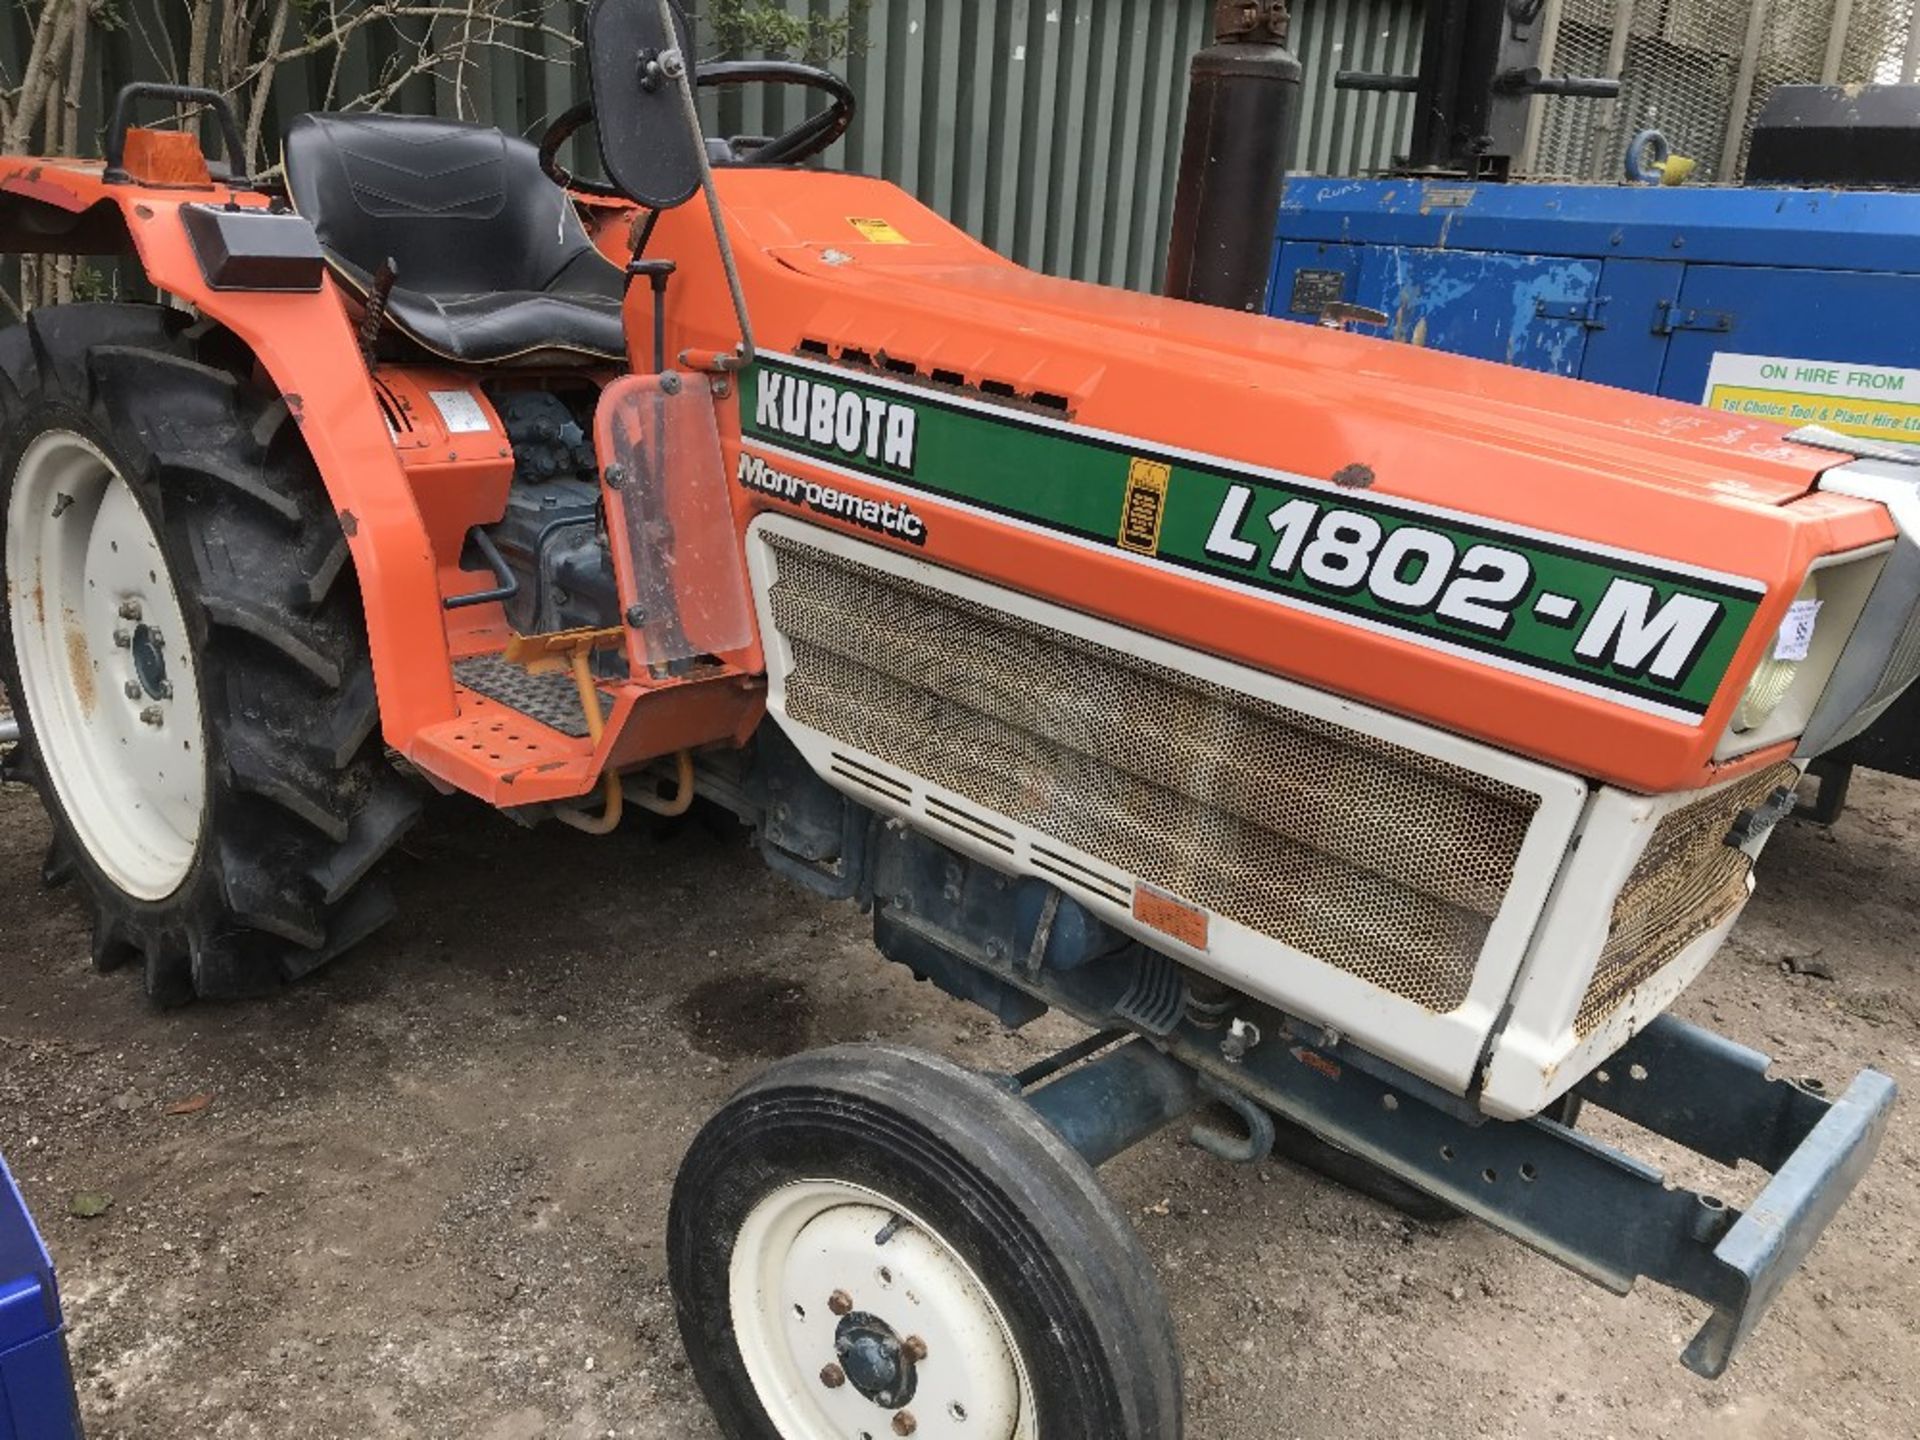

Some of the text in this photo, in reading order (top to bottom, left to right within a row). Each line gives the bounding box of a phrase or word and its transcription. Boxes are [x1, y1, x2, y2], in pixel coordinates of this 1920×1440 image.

[755, 369, 917, 471] KUBOTA
[1722, 398, 1741, 412] 1st
[1742, 399, 1786, 416] Choice
[1789, 403, 1817, 419] Tool
[1818, 406, 1829, 421] &
[1833, 408, 1869, 425] Plant
[1871, 413, 1901, 429] Hire
[1759, 363, 1905, 391] ON HIRE FROM
[736, 451, 926, 540] Monroematic
[1203, 484, 1721, 684] L1802-M
